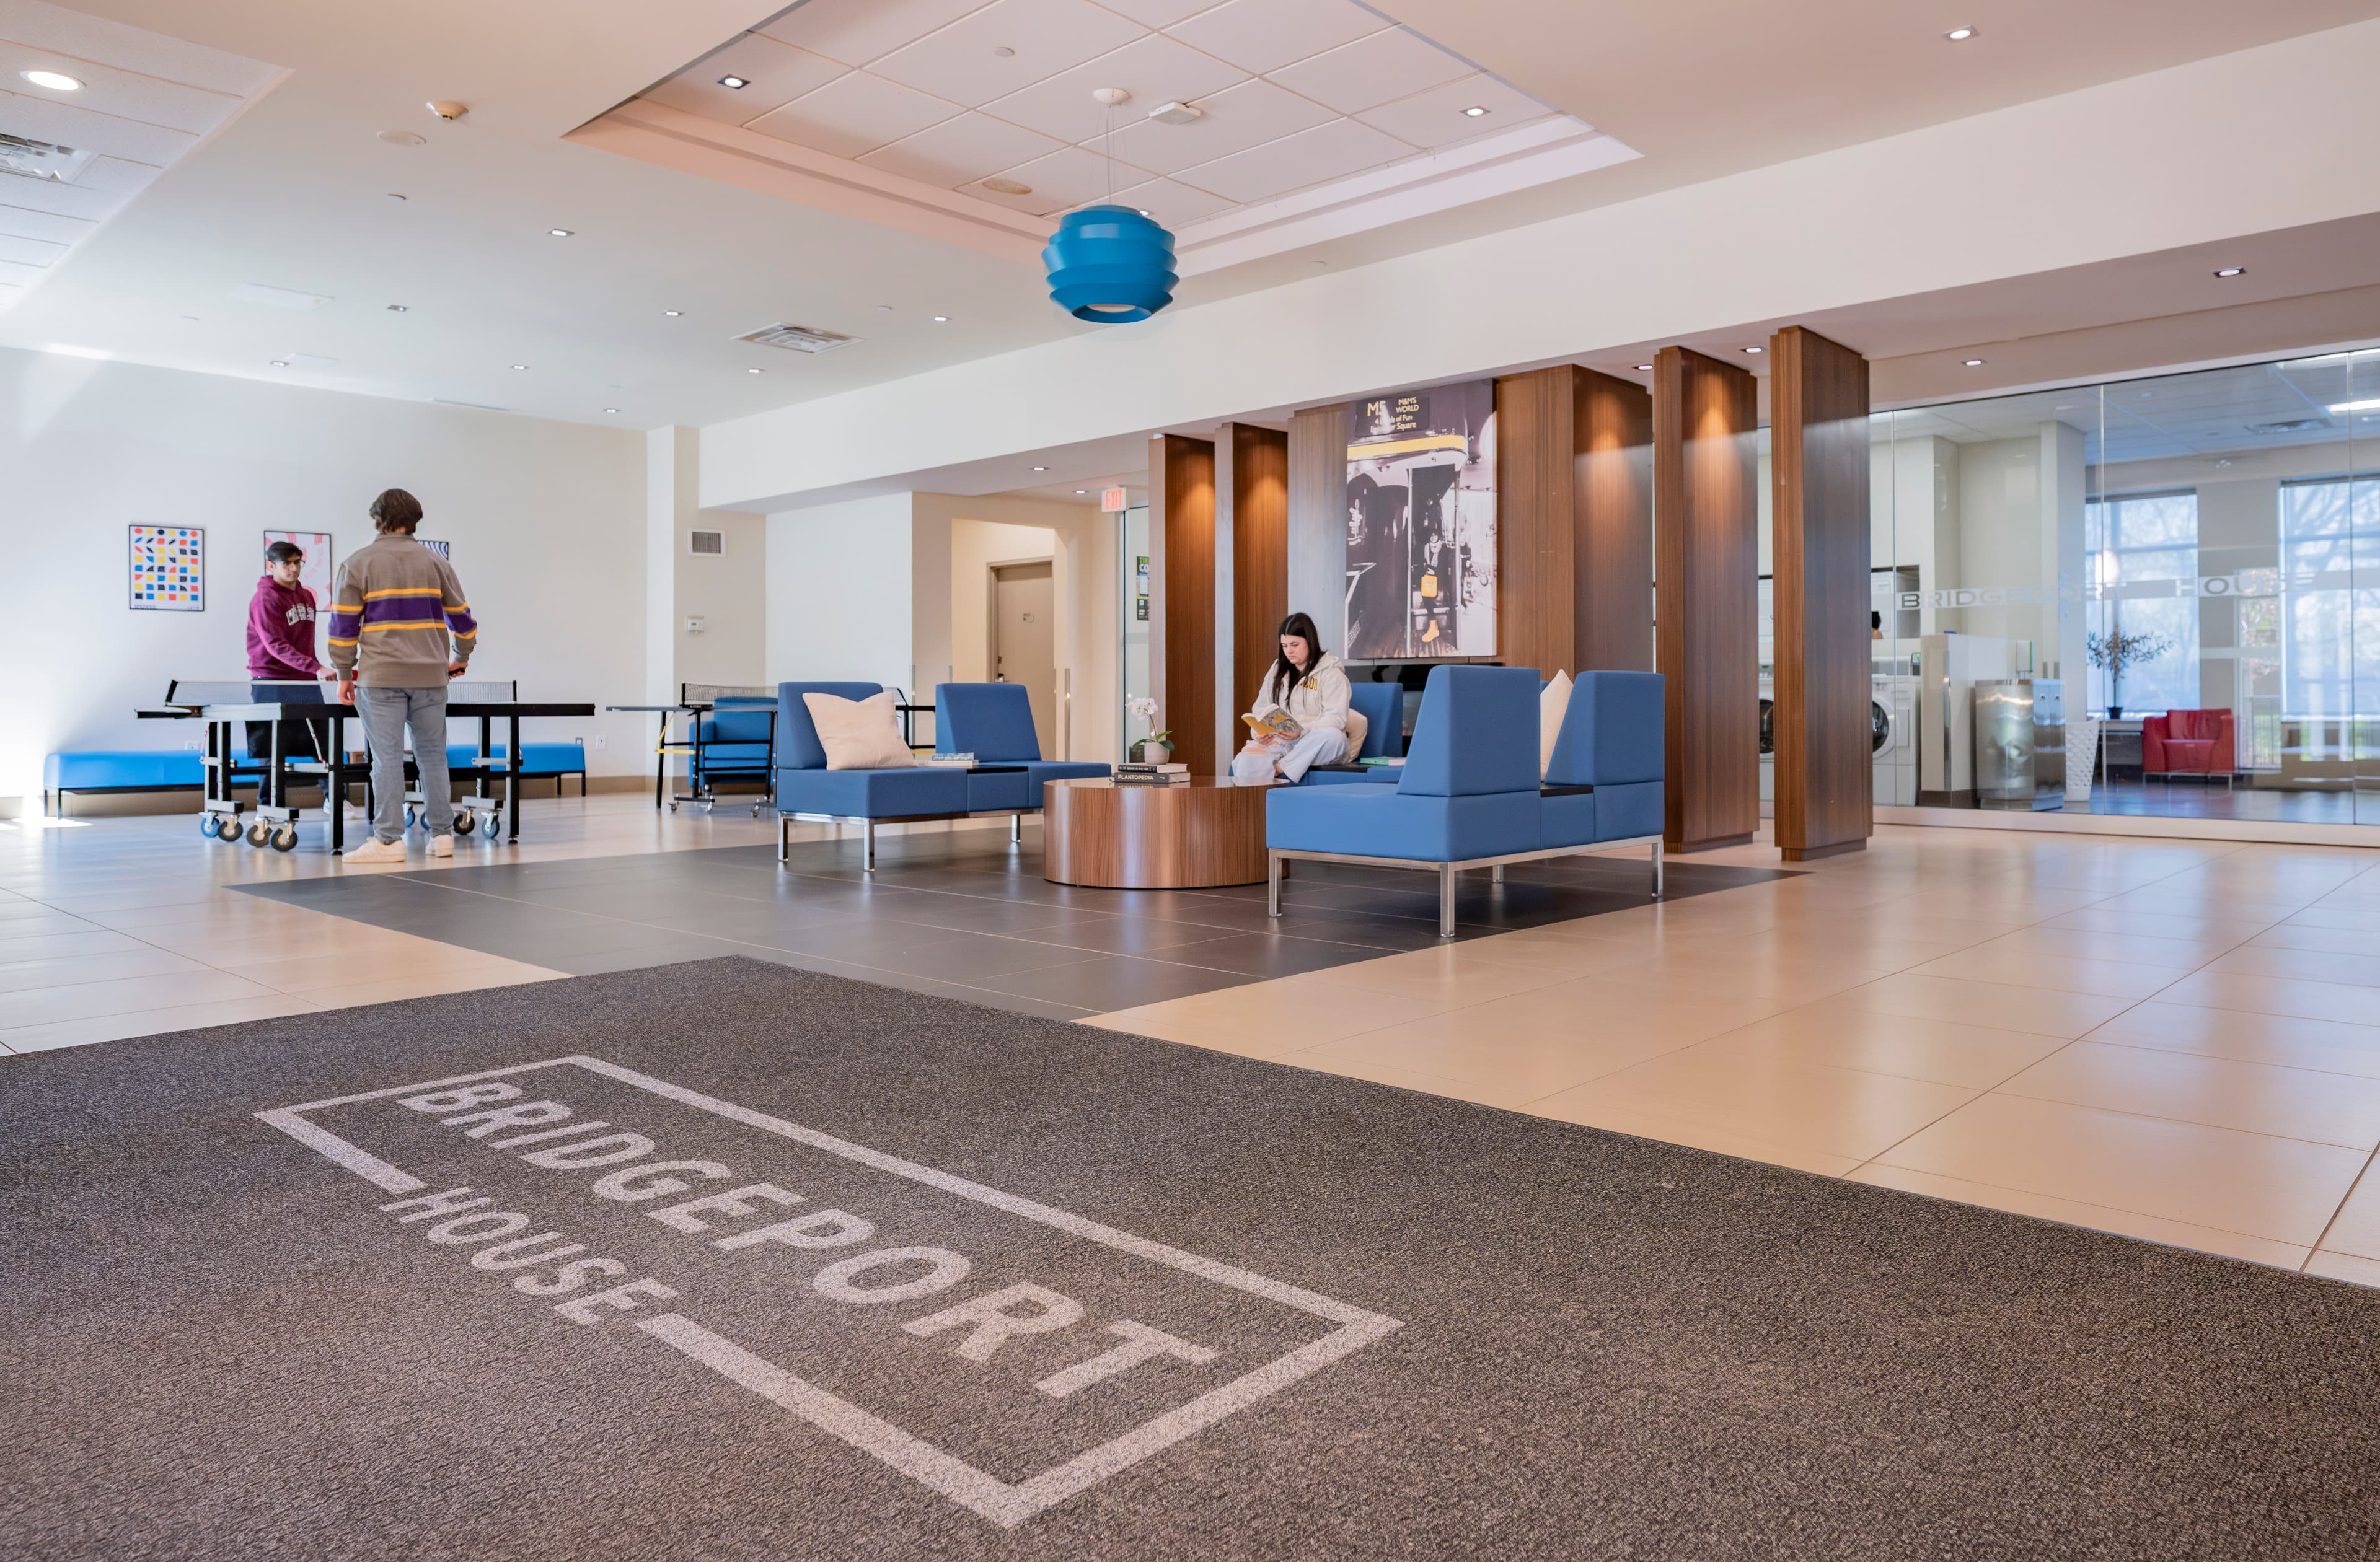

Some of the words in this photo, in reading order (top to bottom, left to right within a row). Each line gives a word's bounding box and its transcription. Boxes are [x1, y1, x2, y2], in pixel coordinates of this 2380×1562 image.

[1396, 405, 1419, 413] WORLD
[1397, 422, 1417, 431] Square
[1106, 489, 1122, 511] EXIT
[395, 1082, 1219, 1398] BRIDGEPORT
[378, 1186, 679, 1327] HOUSE
